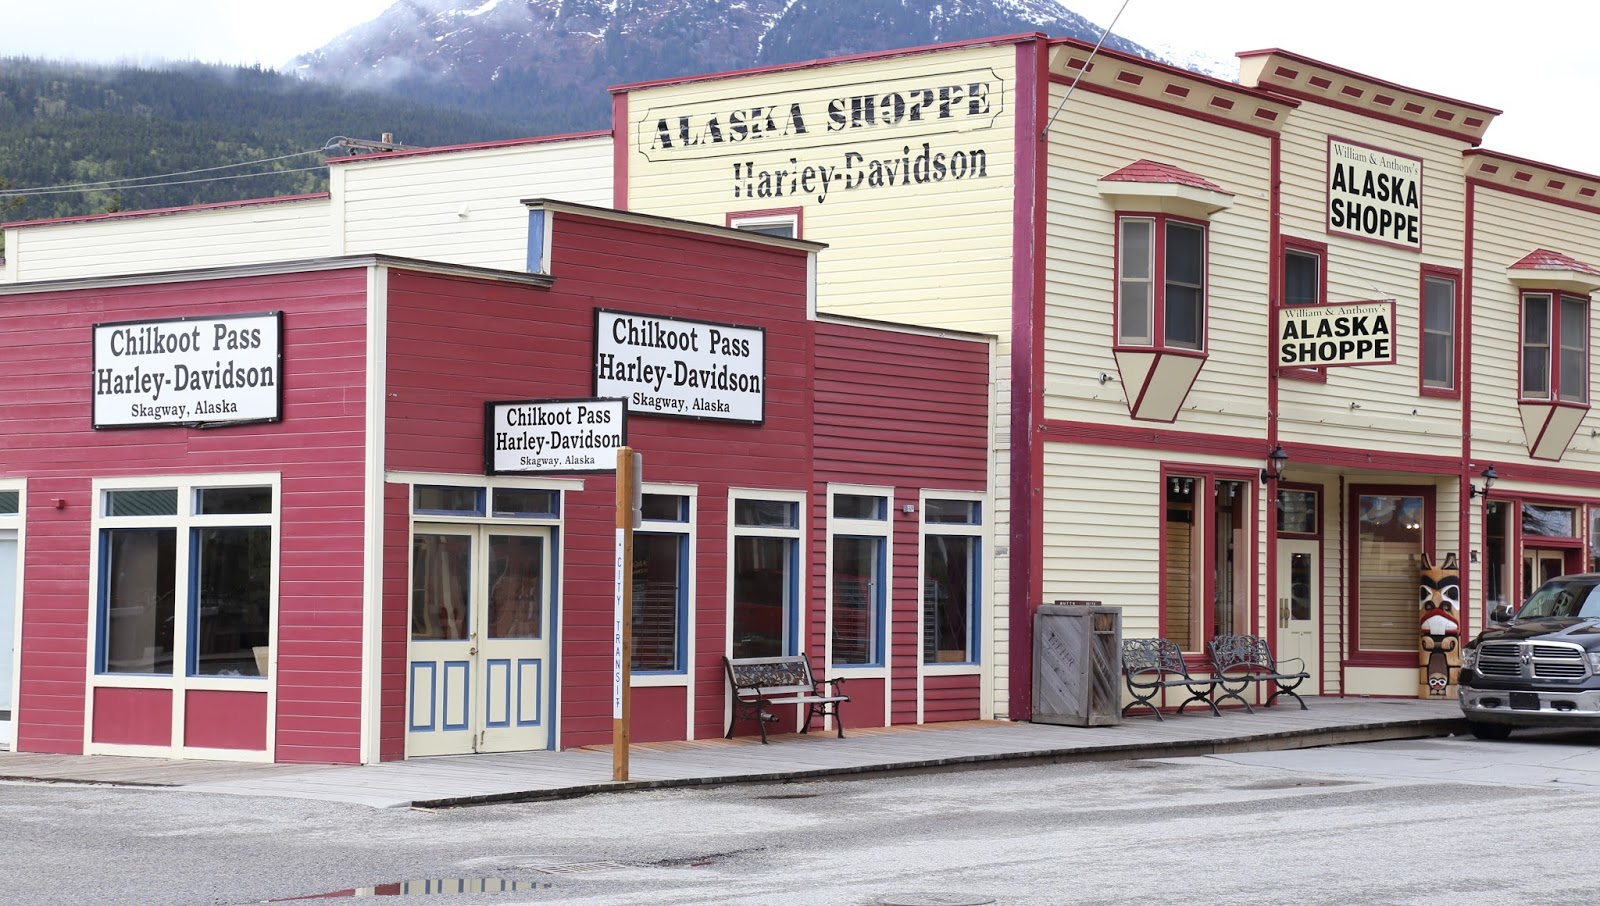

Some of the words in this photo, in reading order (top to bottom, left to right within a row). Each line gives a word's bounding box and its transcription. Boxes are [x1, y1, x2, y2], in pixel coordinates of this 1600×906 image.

[650, 102, 808, 150] ALASKA
[826, 82, 991, 132] SHOPPE
[733, 142, 988, 203] Harley-Davidson
[1334, 143, 1367, 163] William
[1369, 153, 1377, 165] &
[1380, 156, 1418, 176] Anthony's
[1331, 162, 1419, 209] ALASKA
[1331, 198, 1419, 244] SHOPPE
[1282, 315, 1389, 340] ALASKA
[1285, 308, 1322, 318] William
[1325, 308, 1335, 316] &
[1337, 304, 1386, 316] Anthony's
[110, 325, 200, 357] Chilkoot
[213, 323, 261, 351] Pass
[612, 317, 698, 352] Chilkoot
[709, 329, 750, 357] Pass
[1281, 338, 1390, 363] SHOPPE
[97, 360, 274, 401] Harley-Davidson
[598, 353, 761, 394] Harley-Davidson
[131, 403, 190, 420] Skagway,
[195, 399, 238, 414] Alaska
[507, 407, 571, 427] Chilkoot
[577, 406, 611, 424] Pass
[632, 392, 688, 412] Skagway,
[692, 398, 730, 413] Alaska
[496, 429, 621, 455] Harley-Davidson
[520, 456, 562, 467] Skagway,
[565, 455, 595, 465] Alaska
